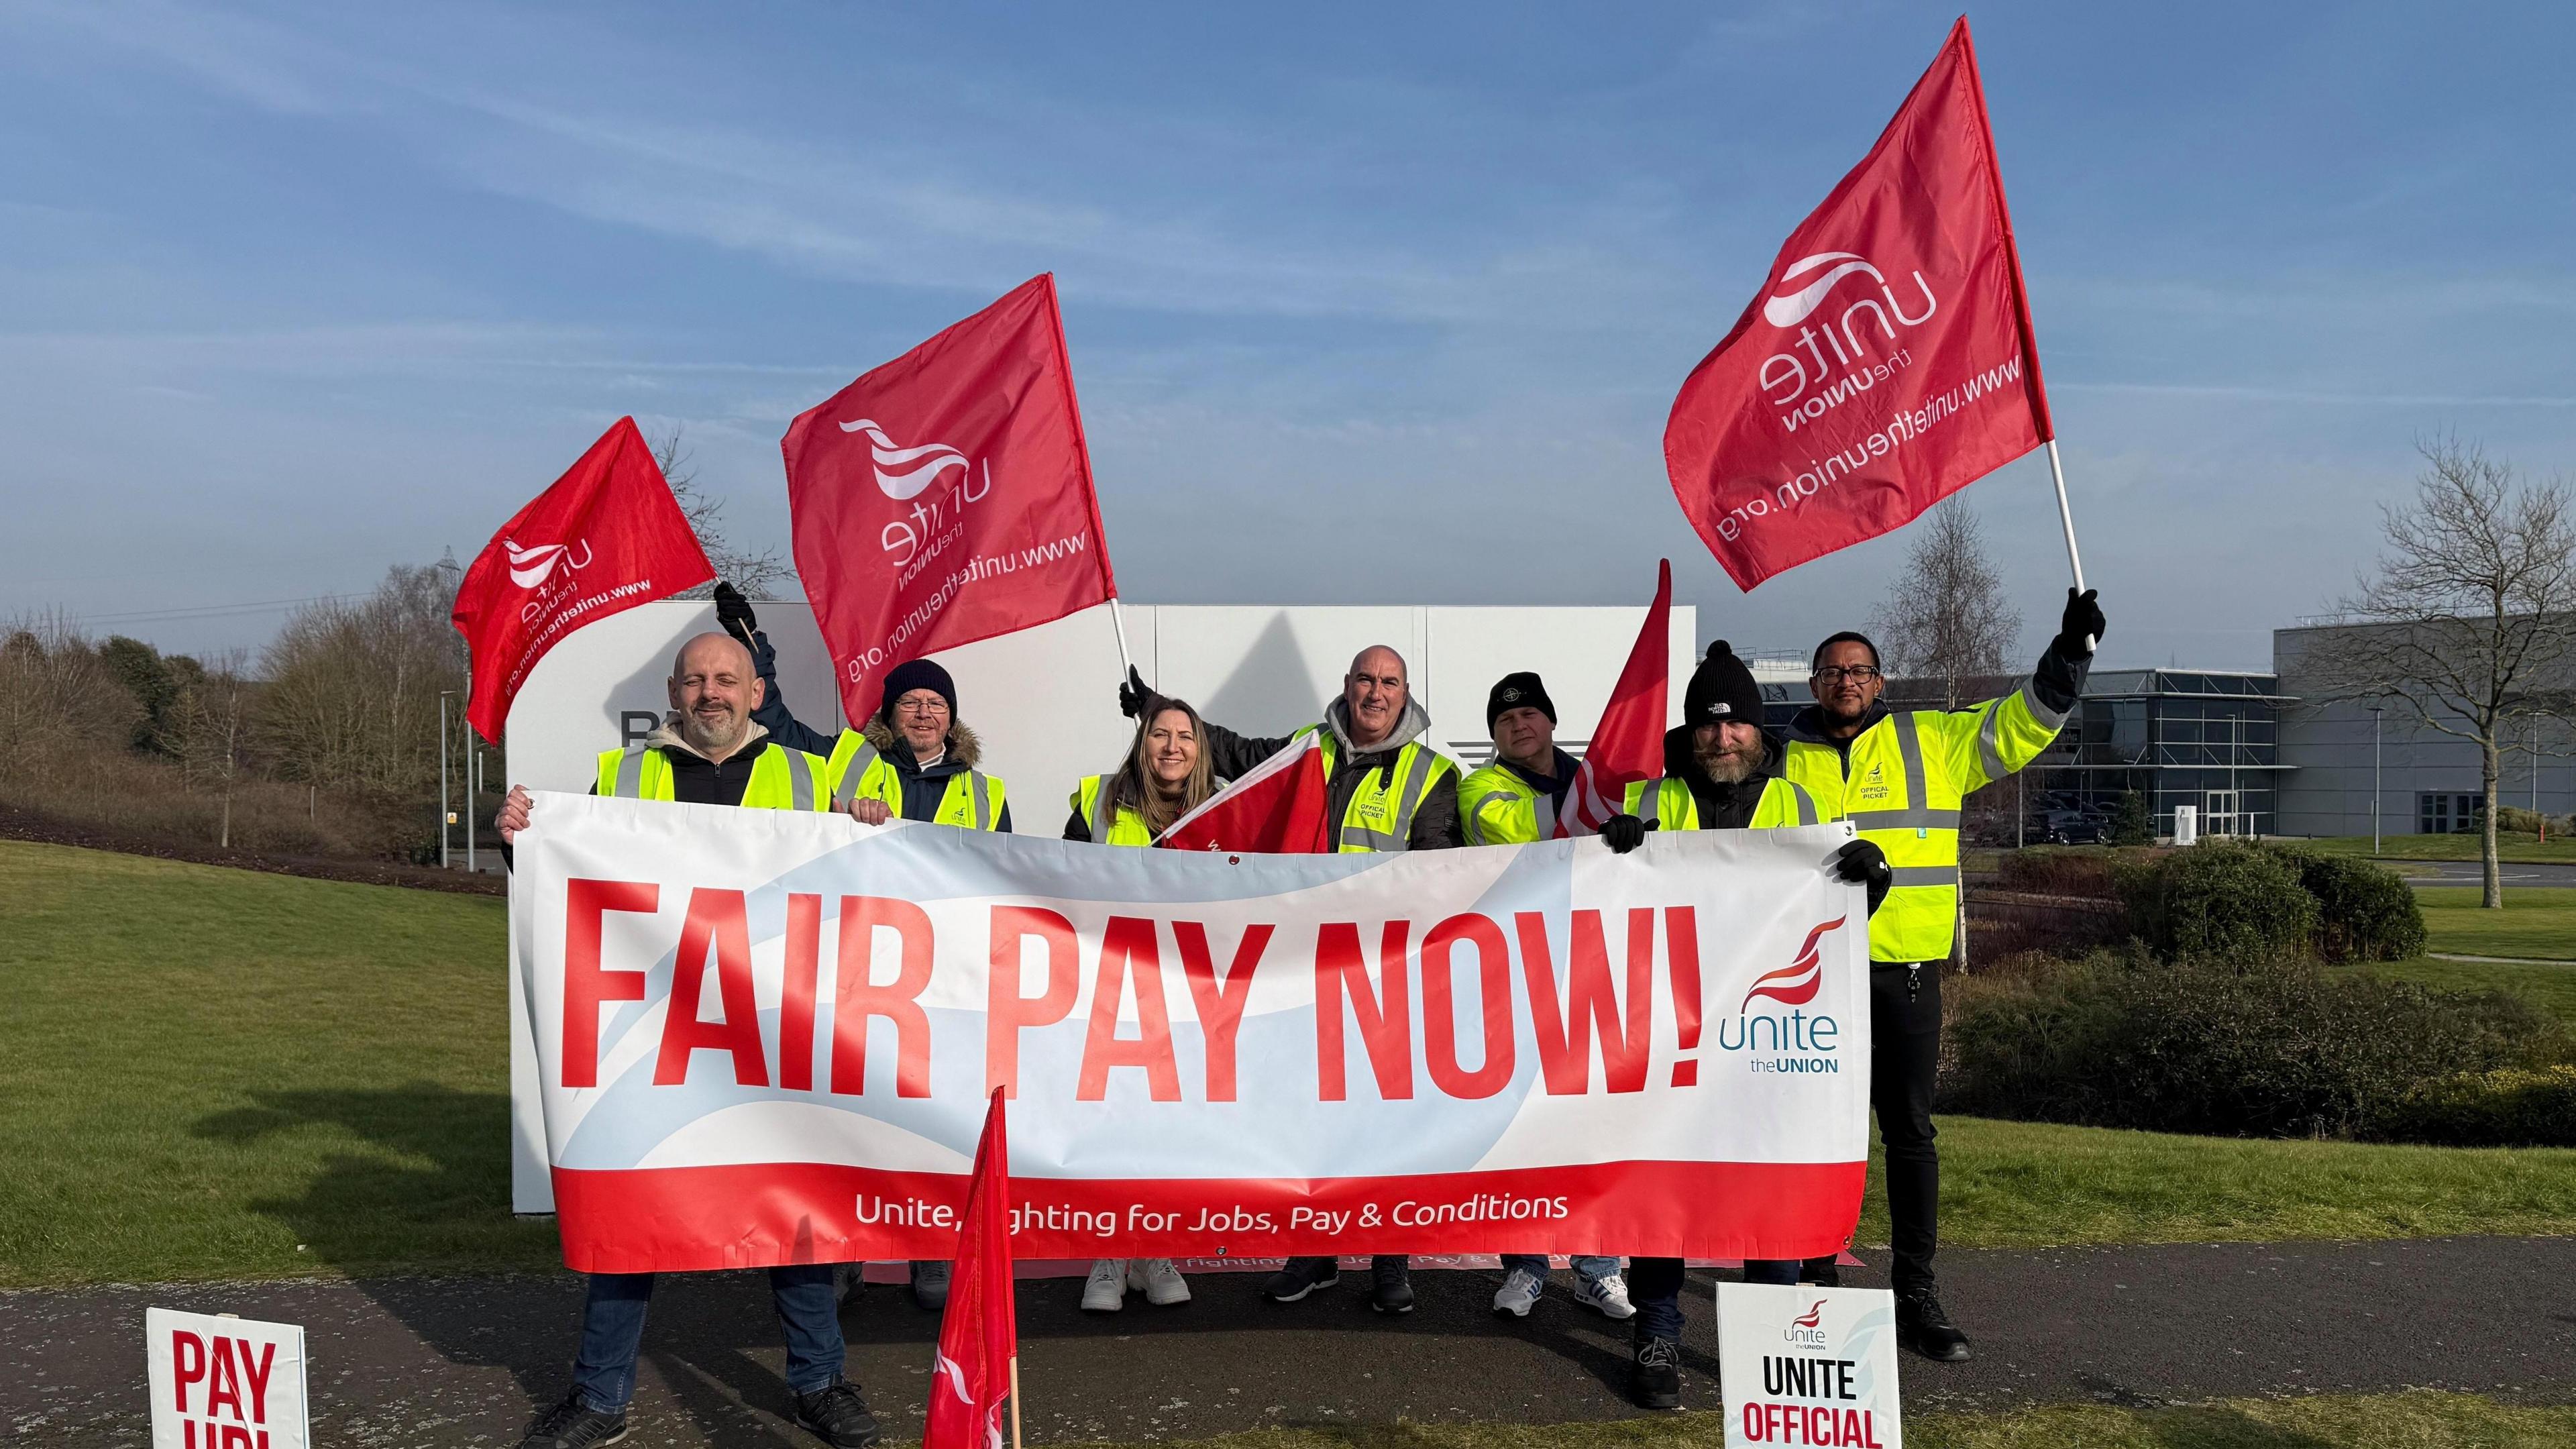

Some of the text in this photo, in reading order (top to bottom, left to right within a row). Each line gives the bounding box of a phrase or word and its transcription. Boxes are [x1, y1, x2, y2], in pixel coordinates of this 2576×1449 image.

[1360, 810, 1383, 818] PICKET
[561, 877, 1701, 1102] FAIR PAY NOW!
[856, 1192, 1568, 1237] Unite, ghting for Jobs, Pay & Conditions
[172, 1329, 276, 1425] PAY
[1763, 1355, 1857, 1400] UNITE
[1743, 1402, 1884, 1449] OFFICIAL
